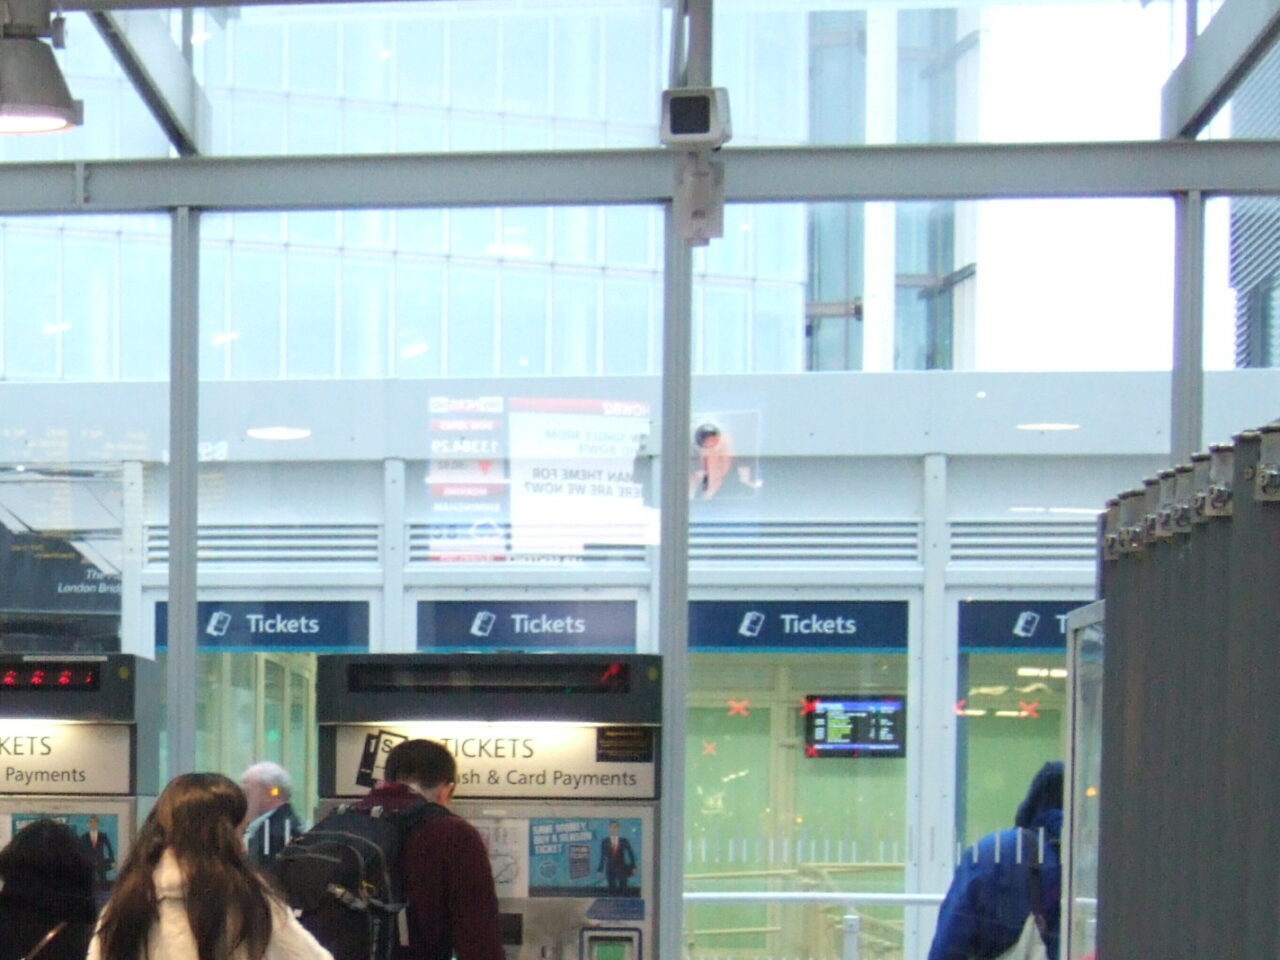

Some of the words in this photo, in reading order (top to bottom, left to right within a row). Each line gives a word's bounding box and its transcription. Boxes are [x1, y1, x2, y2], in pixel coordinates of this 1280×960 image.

[246, 614, 319, 633] Tickets
[511, 614, 586, 634] Tickets
[780, 614, 857, 634] Tickets
[5, 766, 86, 786] Payments
[487, 769, 500, 786] &
[506, 769, 547, 786] Card
[553, 770, 638, 790] Payments
